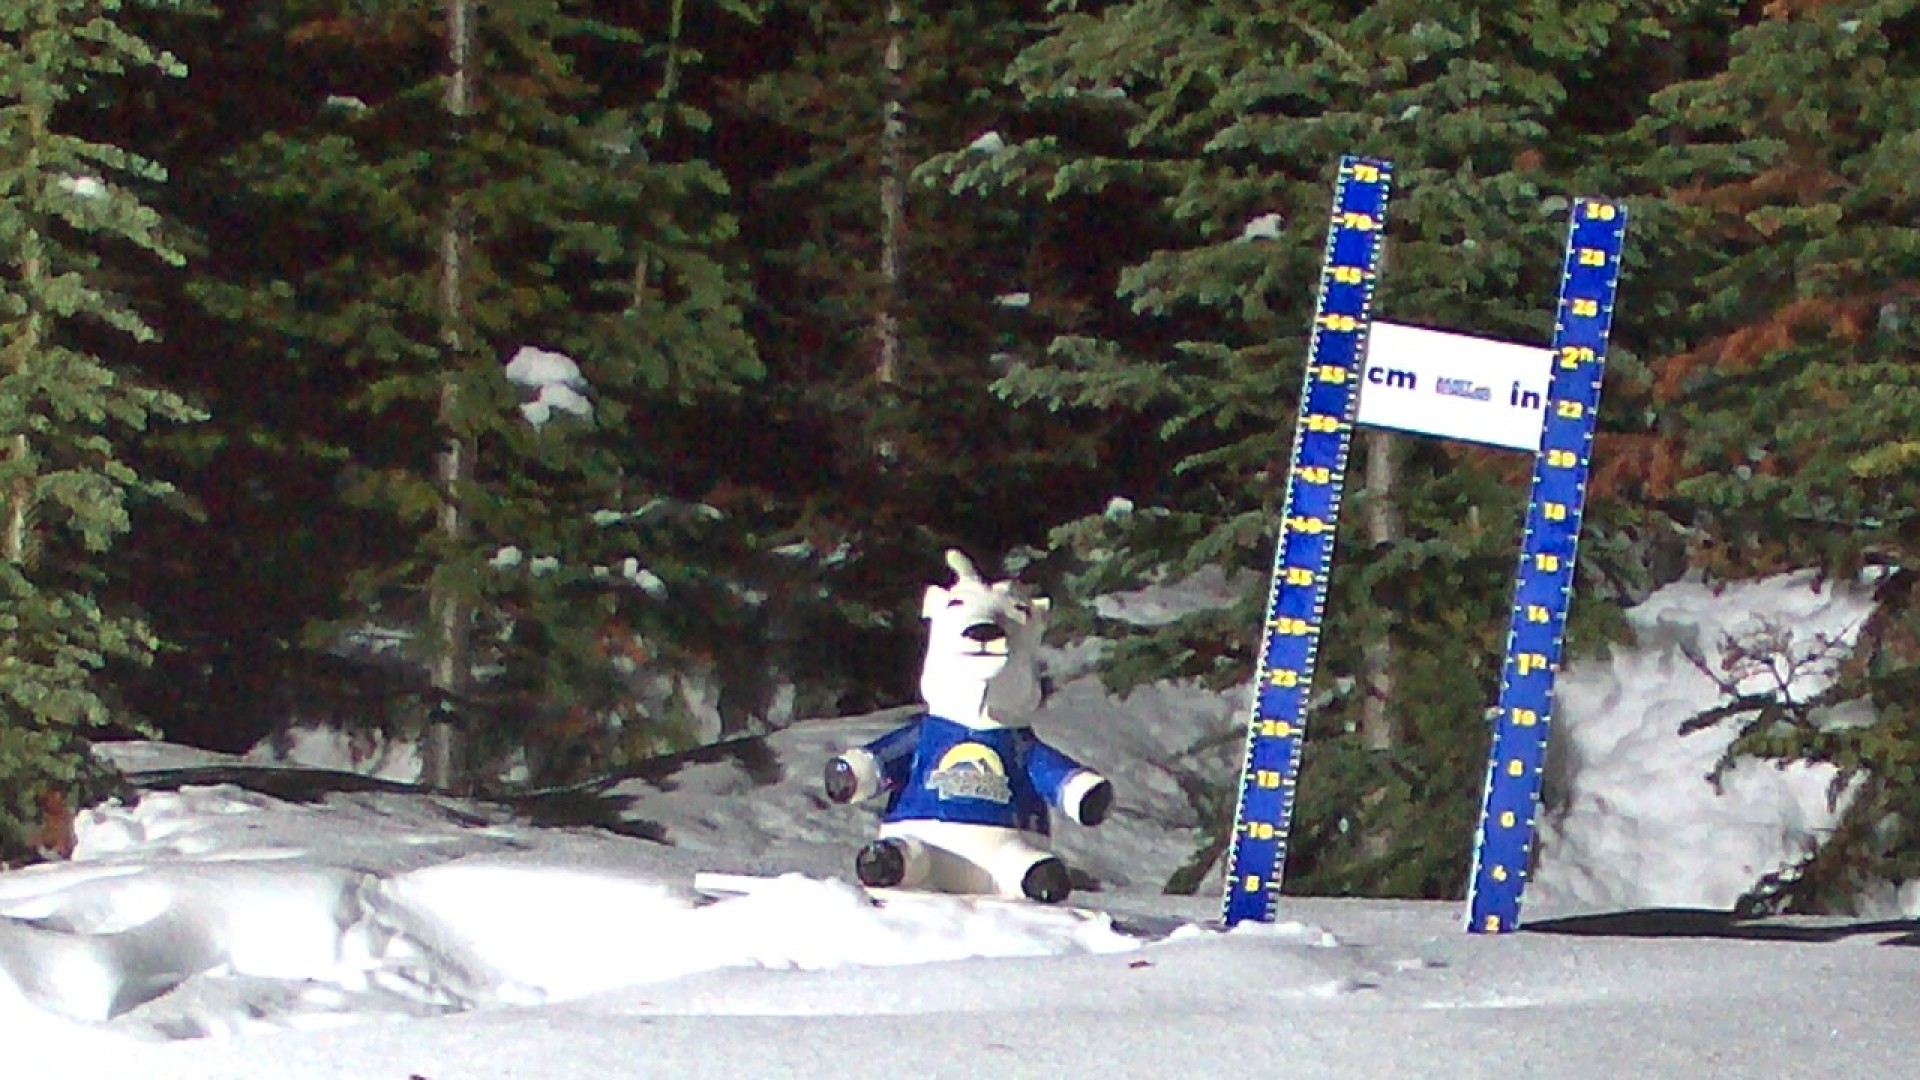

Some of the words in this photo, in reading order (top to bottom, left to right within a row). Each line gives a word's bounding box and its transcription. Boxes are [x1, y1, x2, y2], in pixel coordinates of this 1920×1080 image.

[1344, 212, 1372, 231] 70
[1326, 313, 1356, 331] 60
[1319, 365, 1345, 384] 55
[1368, 366, 1417, 390] cm
[1510, 380, 1541, 410] in
[1309, 414, 1337, 432] 50
[1548, 449, 1576, 468] 20
[1302, 466, 1329, 484] 45
[1293, 516, 1323, 534] 40
[1286, 567, 1314, 586] 35
[1271, 668, 1297, 688] 25
[1512, 707, 1537, 726] 10
[1261, 719, 1290, 737] 20
[1257, 769, 1280, 789] 15
[1248, 821, 1274, 840] 10
[1245, 875, 1260, 892] 5
[1485, 915, 1500, 933] 2
